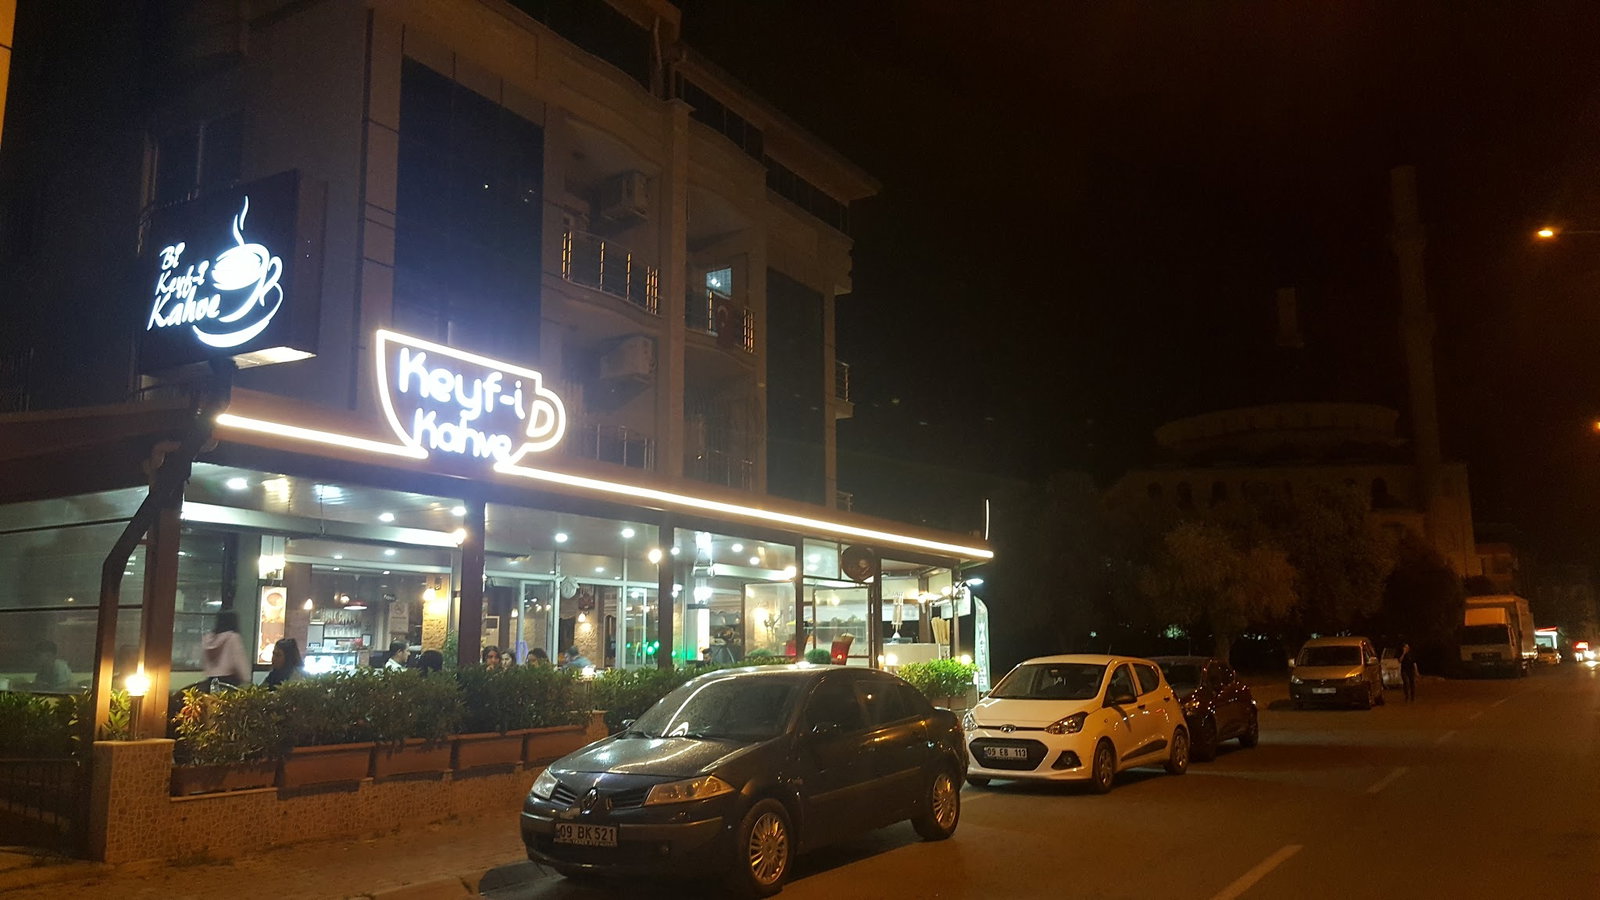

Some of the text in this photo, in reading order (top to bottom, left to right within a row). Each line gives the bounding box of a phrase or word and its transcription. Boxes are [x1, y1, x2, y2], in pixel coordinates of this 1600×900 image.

[147, 285, 221, 331] Kahve
[399, 347, 526, 420] Keyf-i
[413, 407, 513, 464] Kahve
[1014, 749, 1026, 757] 113
[560, 825, 614, 841] 09 BK 521
